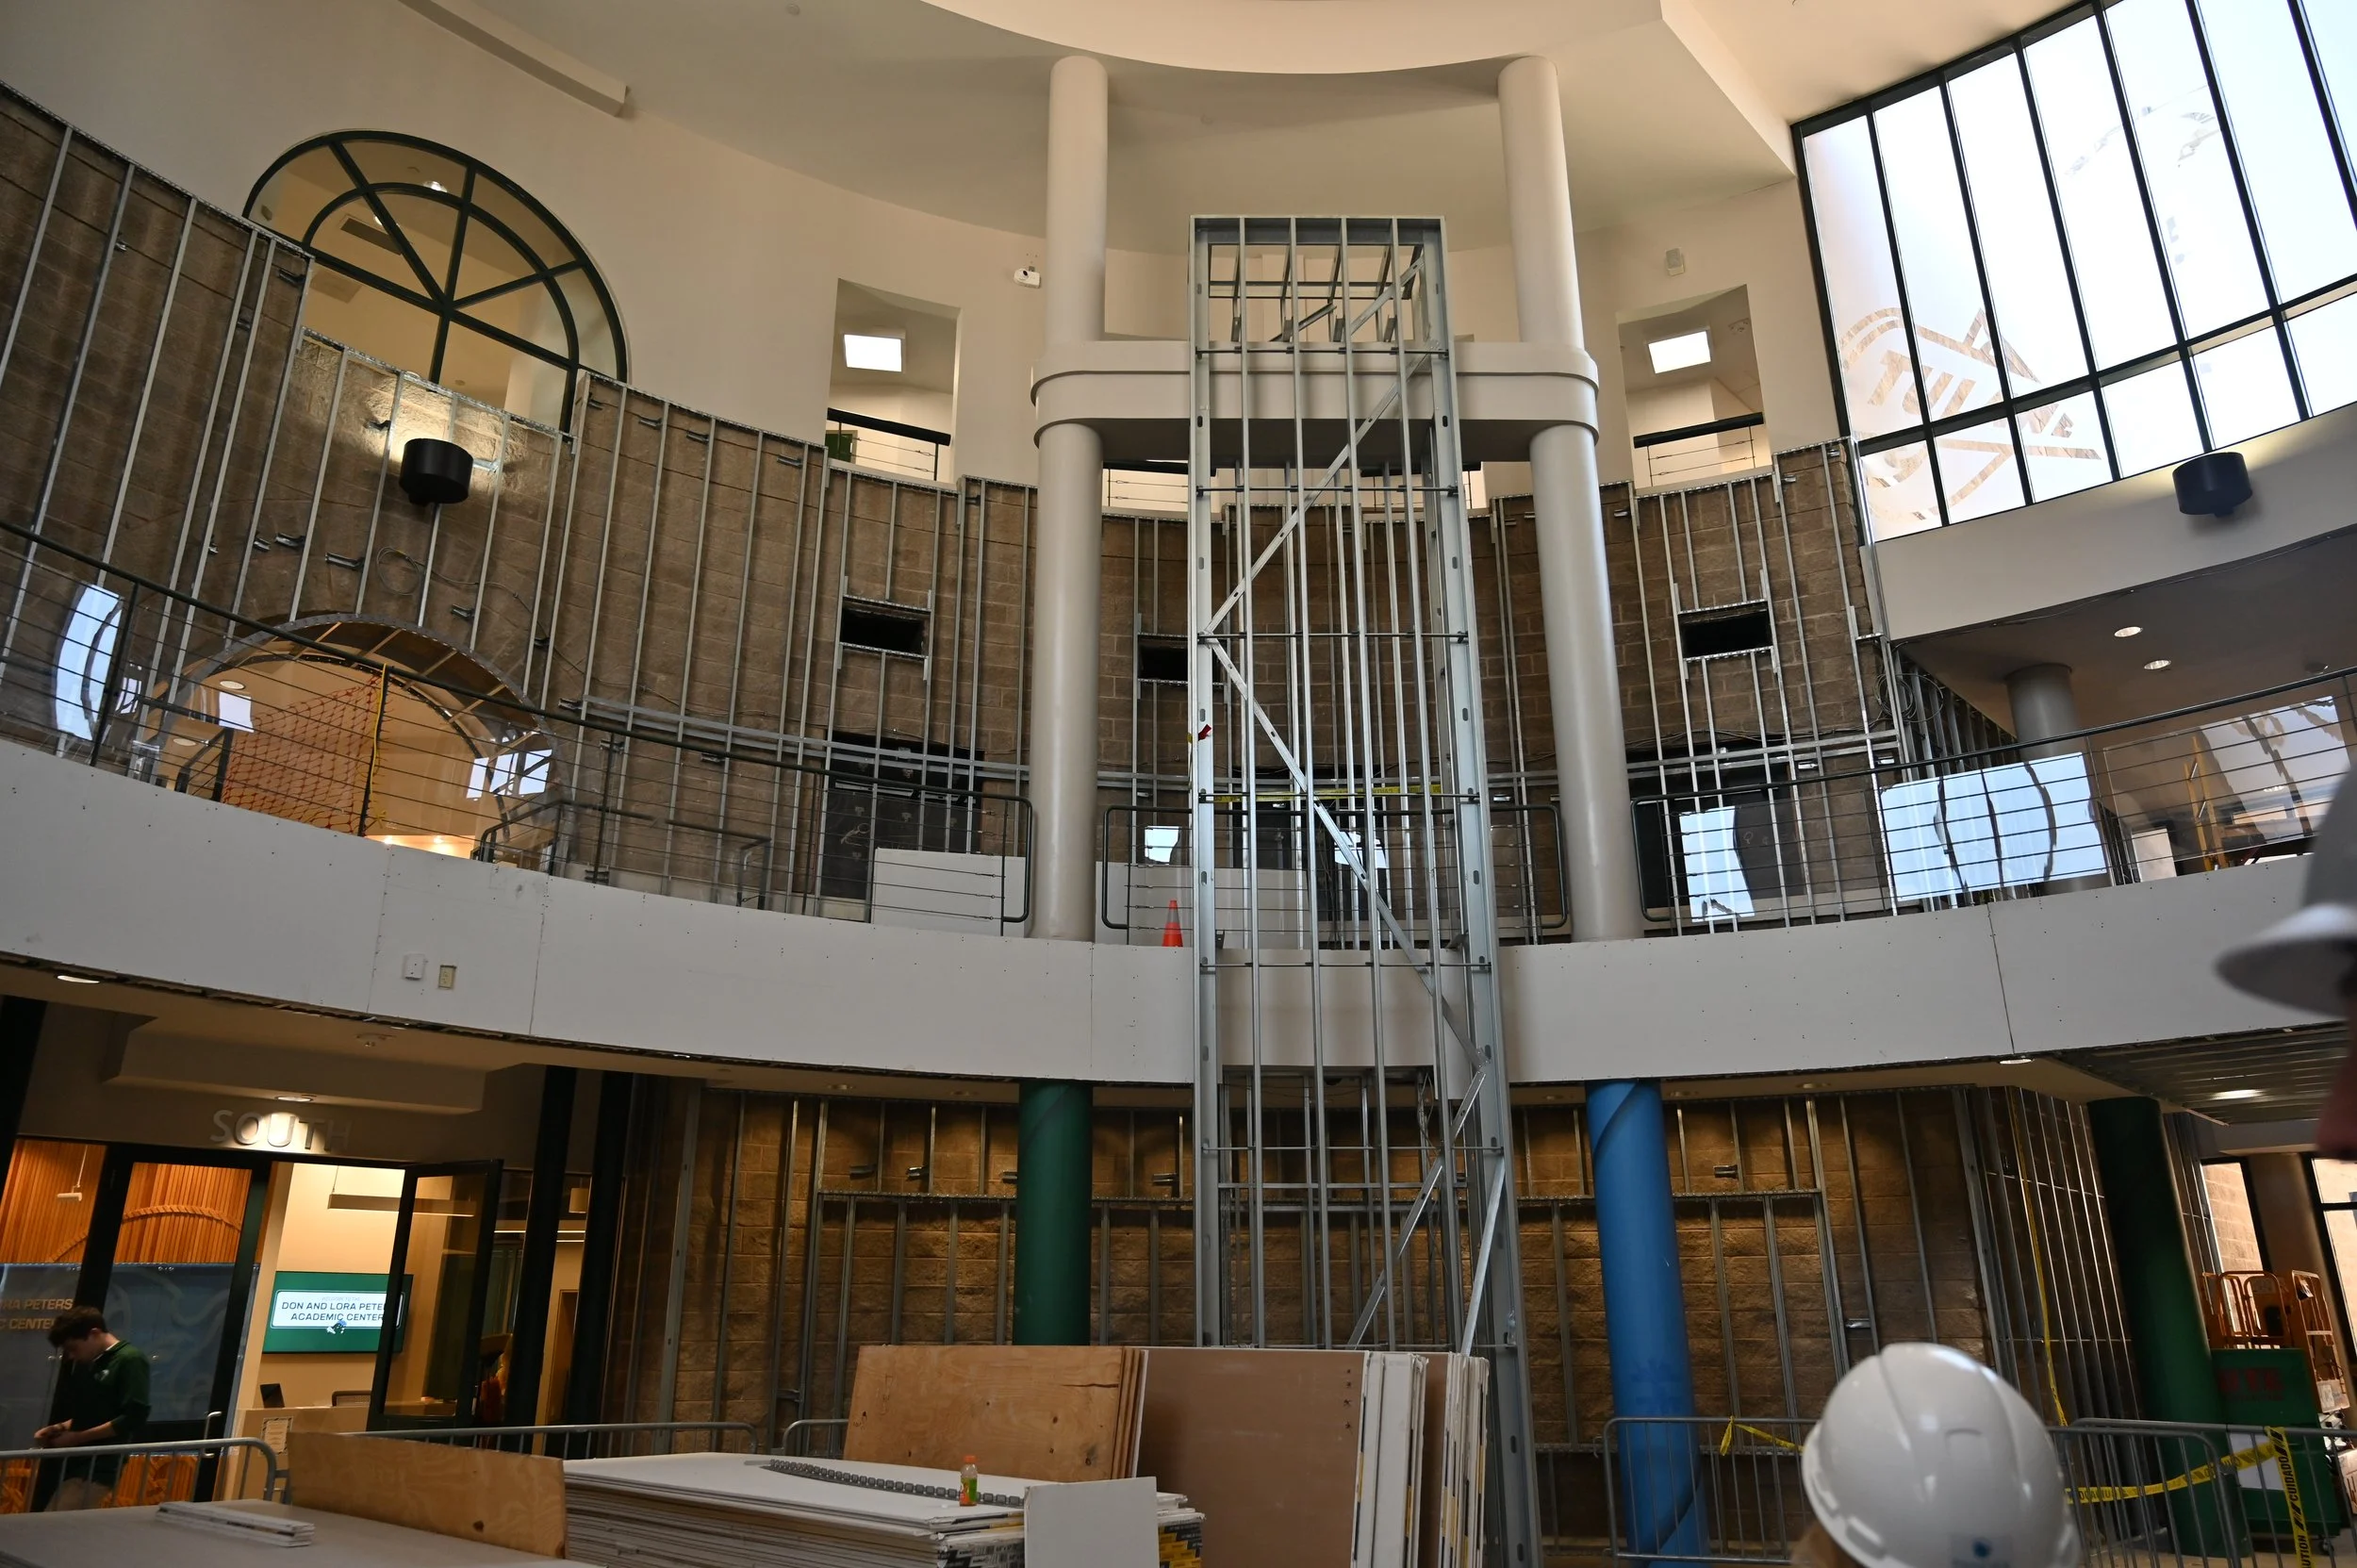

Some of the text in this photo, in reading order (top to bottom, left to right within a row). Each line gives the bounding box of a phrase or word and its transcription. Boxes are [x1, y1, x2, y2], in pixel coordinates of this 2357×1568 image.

[209, 1109, 353, 1151] SOUTH
[24, 1298, 74, 1310] PETERS
[281, 1301, 385, 1311] DON AND LORA PETE
[290, 1312, 344, 1321] ACADEMIC
[2277, 1456, 2299, 1501] CUIDADO
